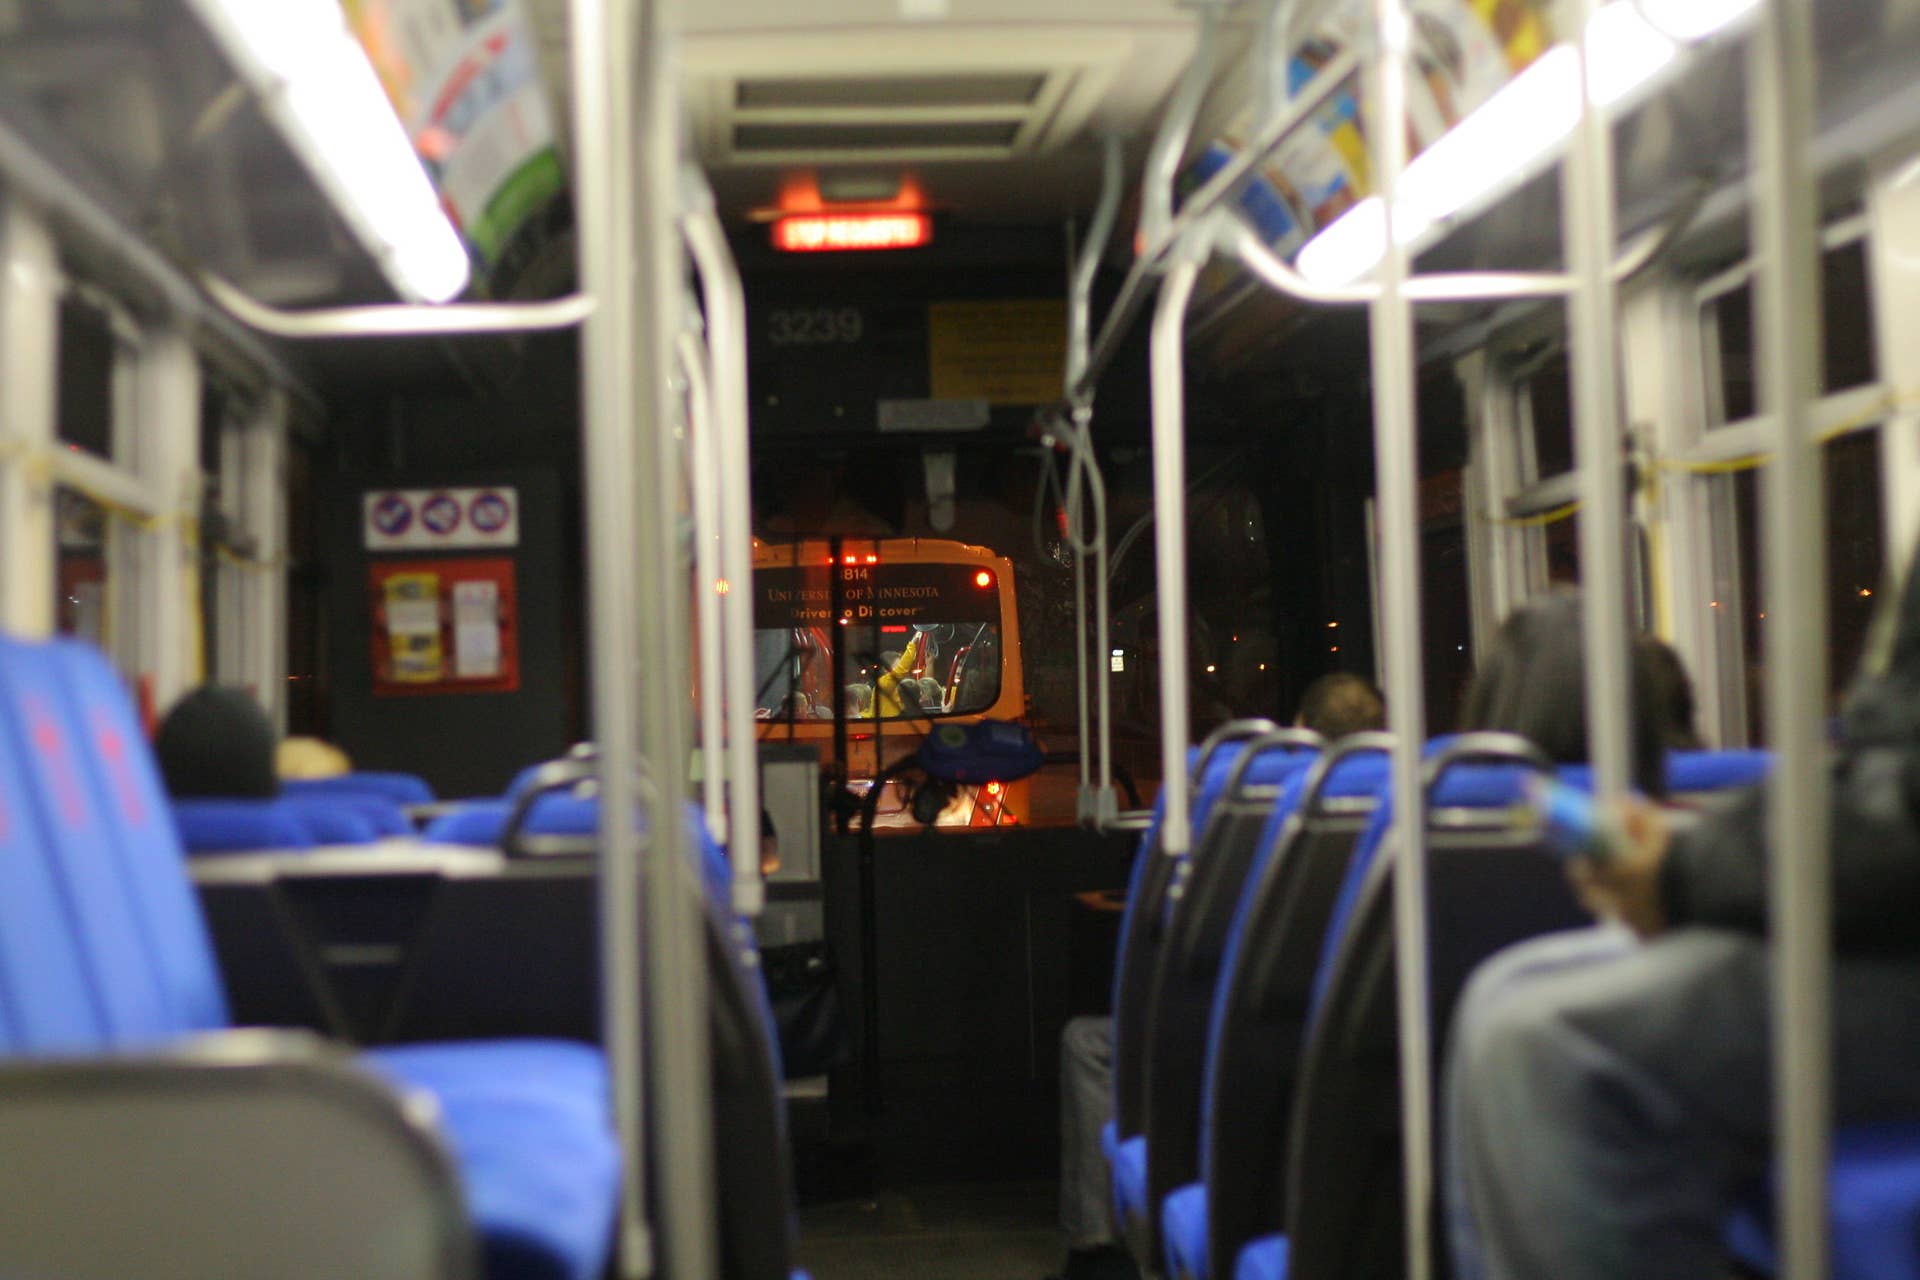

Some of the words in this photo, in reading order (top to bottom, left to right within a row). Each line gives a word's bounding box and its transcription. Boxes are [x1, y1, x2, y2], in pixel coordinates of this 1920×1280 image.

[768, 308, 864, 345] 3239
[844, 567, 868, 580] 814
[859, 605, 919, 618] Dicover
